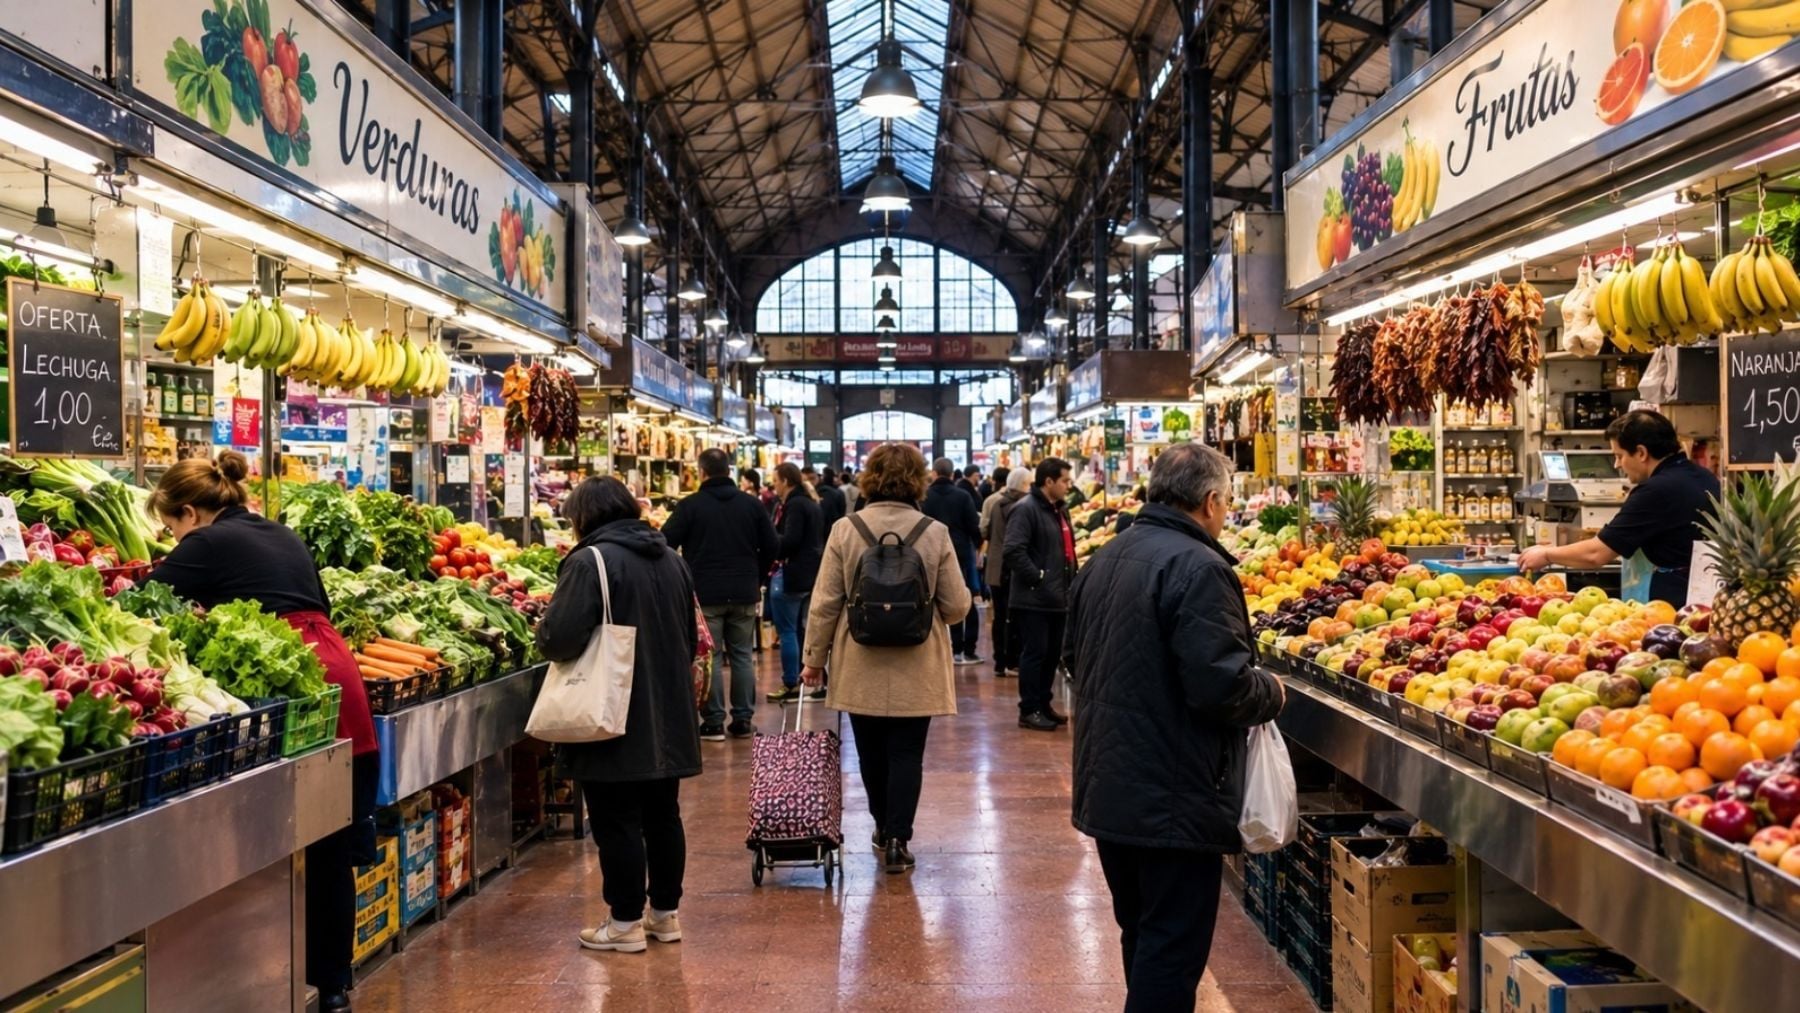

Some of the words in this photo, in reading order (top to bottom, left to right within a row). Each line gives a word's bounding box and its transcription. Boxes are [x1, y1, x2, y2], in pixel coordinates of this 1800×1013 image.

[333, 61, 480, 235] Verduras
[1447, 42, 1580, 177] Frutas
[34, 387, 92, 430] 1,00
[1743, 387, 1800, 434] 1,50
